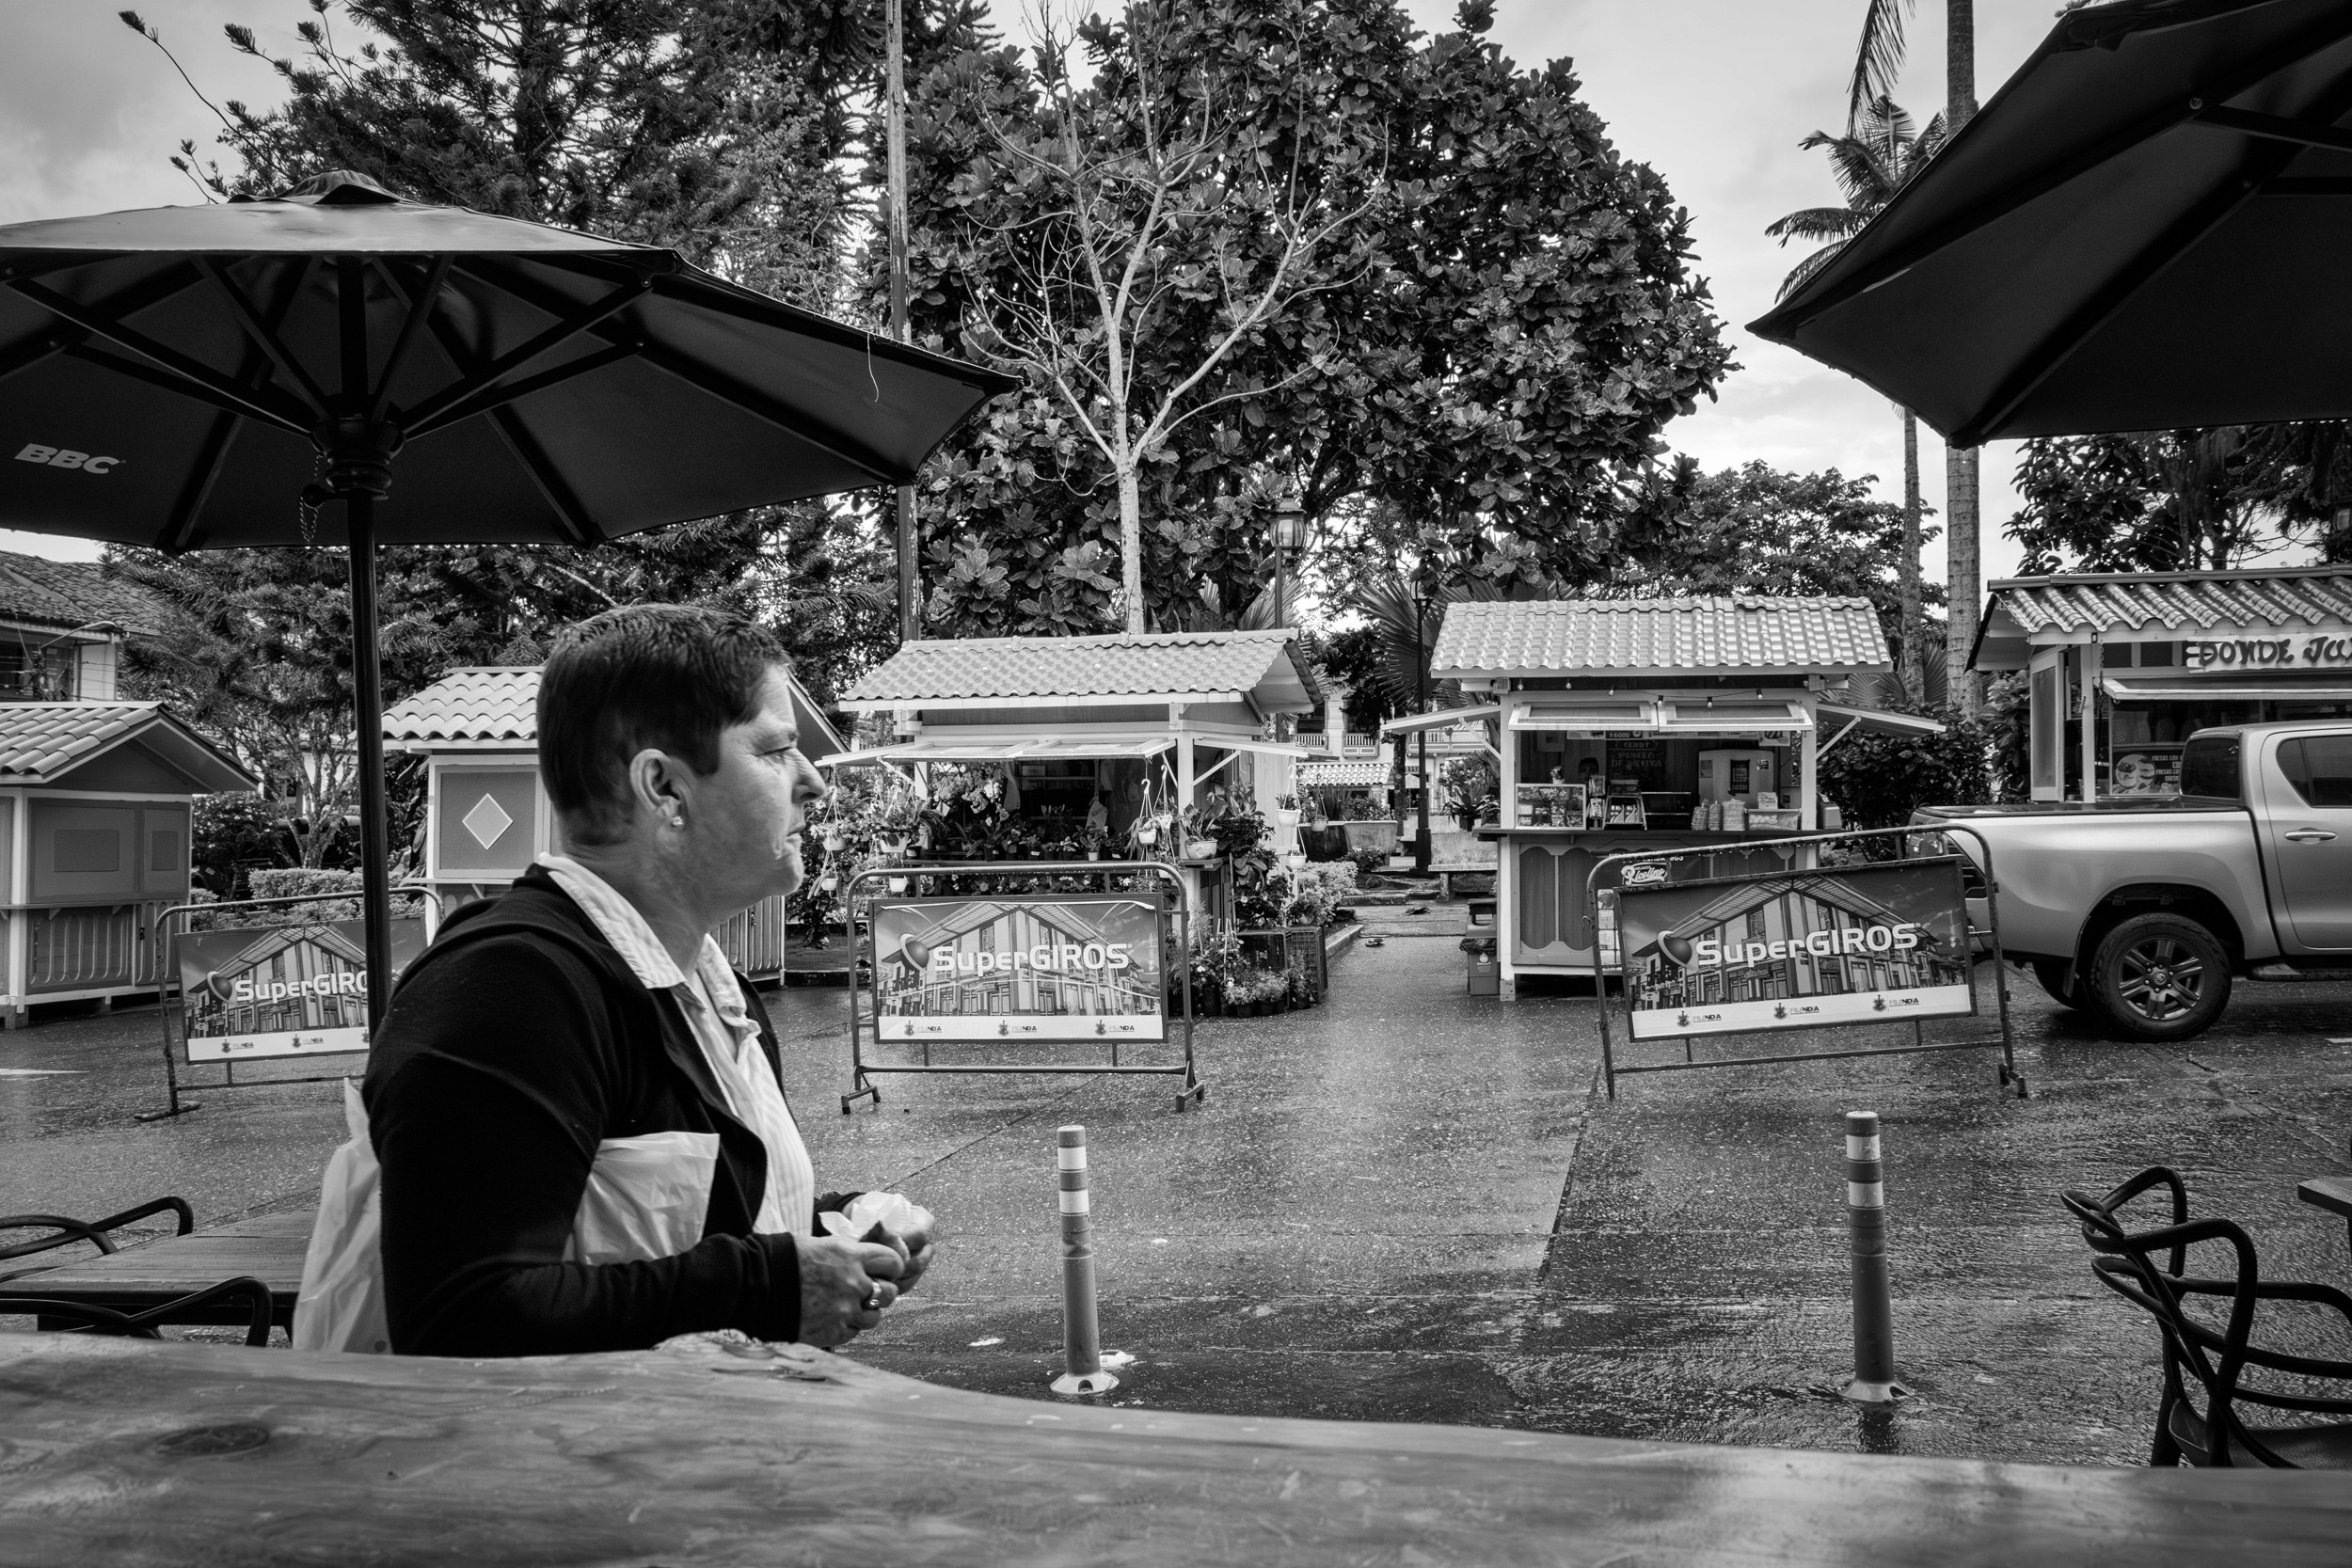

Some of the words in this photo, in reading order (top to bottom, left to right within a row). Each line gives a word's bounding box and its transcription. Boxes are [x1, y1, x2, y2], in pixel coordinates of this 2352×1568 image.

[14, 442, 120, 474] BBC
[933, 942, 1130, 977] SuperGIROS
[1696, 923, 1918, 968] SuperGIROS
